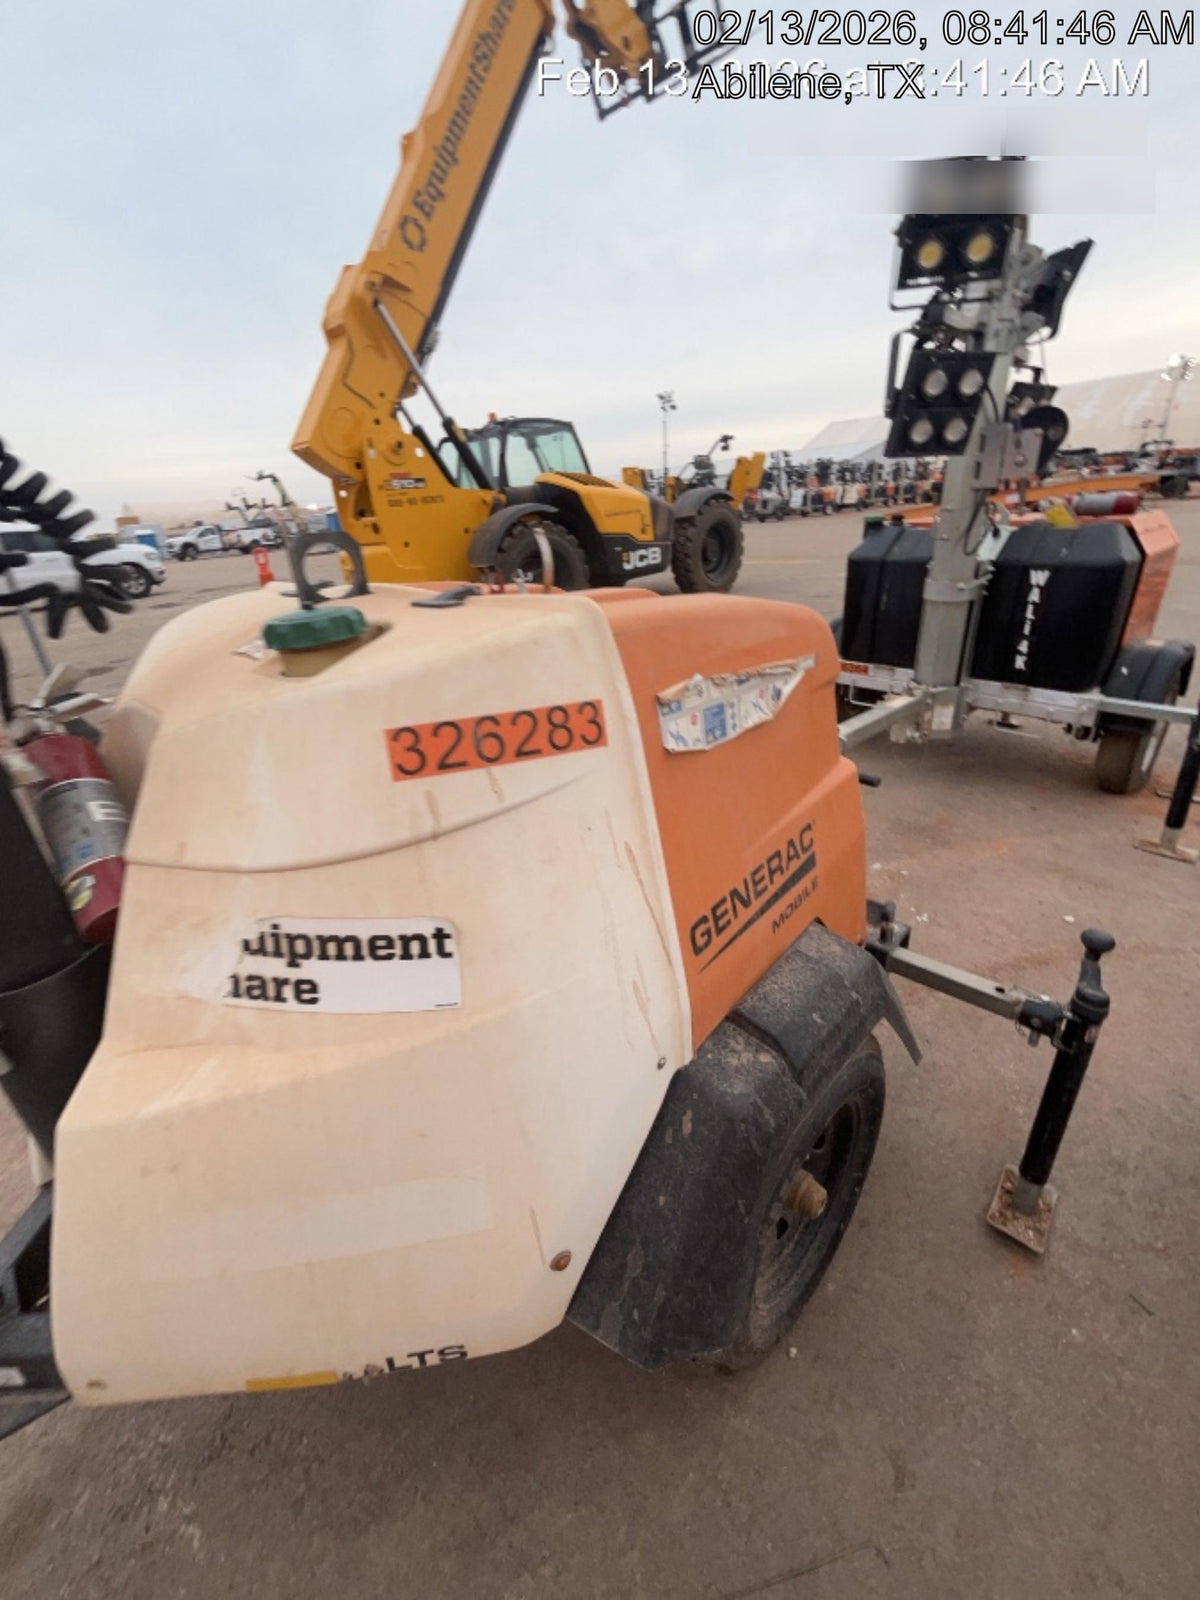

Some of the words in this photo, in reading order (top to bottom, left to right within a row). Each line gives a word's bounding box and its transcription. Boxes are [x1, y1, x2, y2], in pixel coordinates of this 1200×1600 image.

[622, 546, 662, 571] JCB
[391, 701, 603, 776] 326283
[689, 823, 815, 957] GENERAC
[771, 876, 819, 934] MOBILE
